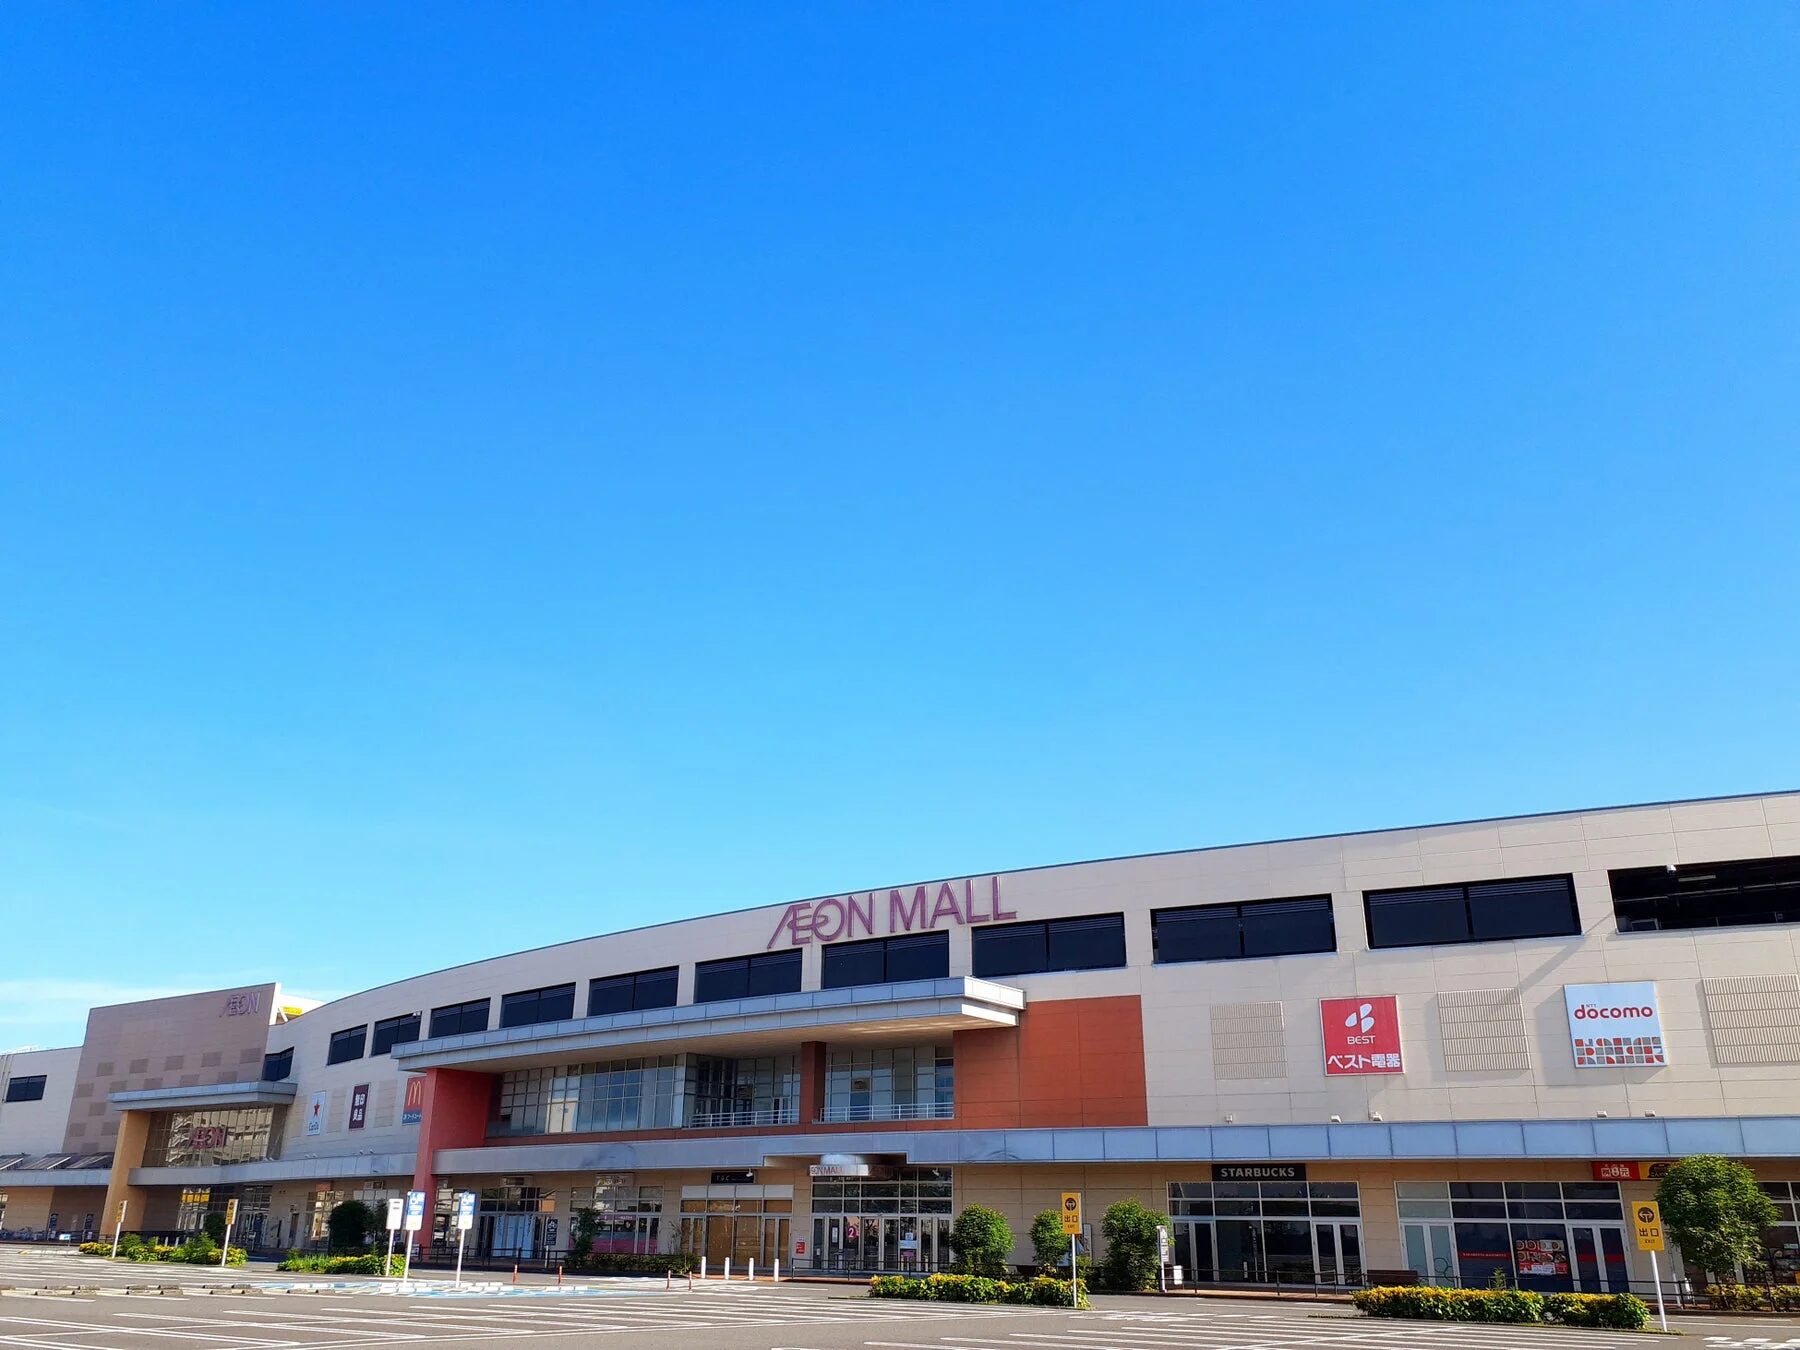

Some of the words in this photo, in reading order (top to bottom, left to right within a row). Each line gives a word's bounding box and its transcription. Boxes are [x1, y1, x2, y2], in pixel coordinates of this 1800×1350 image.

[889, 875, 1017, 934] MALL
[1574, 1004, 1653, 1020] docomo
[1347, 1035, 1376, 1045] BEST
[1327, 1053, 1401, 1069] ベスト電器
[1220, 1167, 1295, 1177] STARBUCKS
[1064, 1215, 1078, 1223] 出口
[1639, 1228, 1659, 1237] 出口
